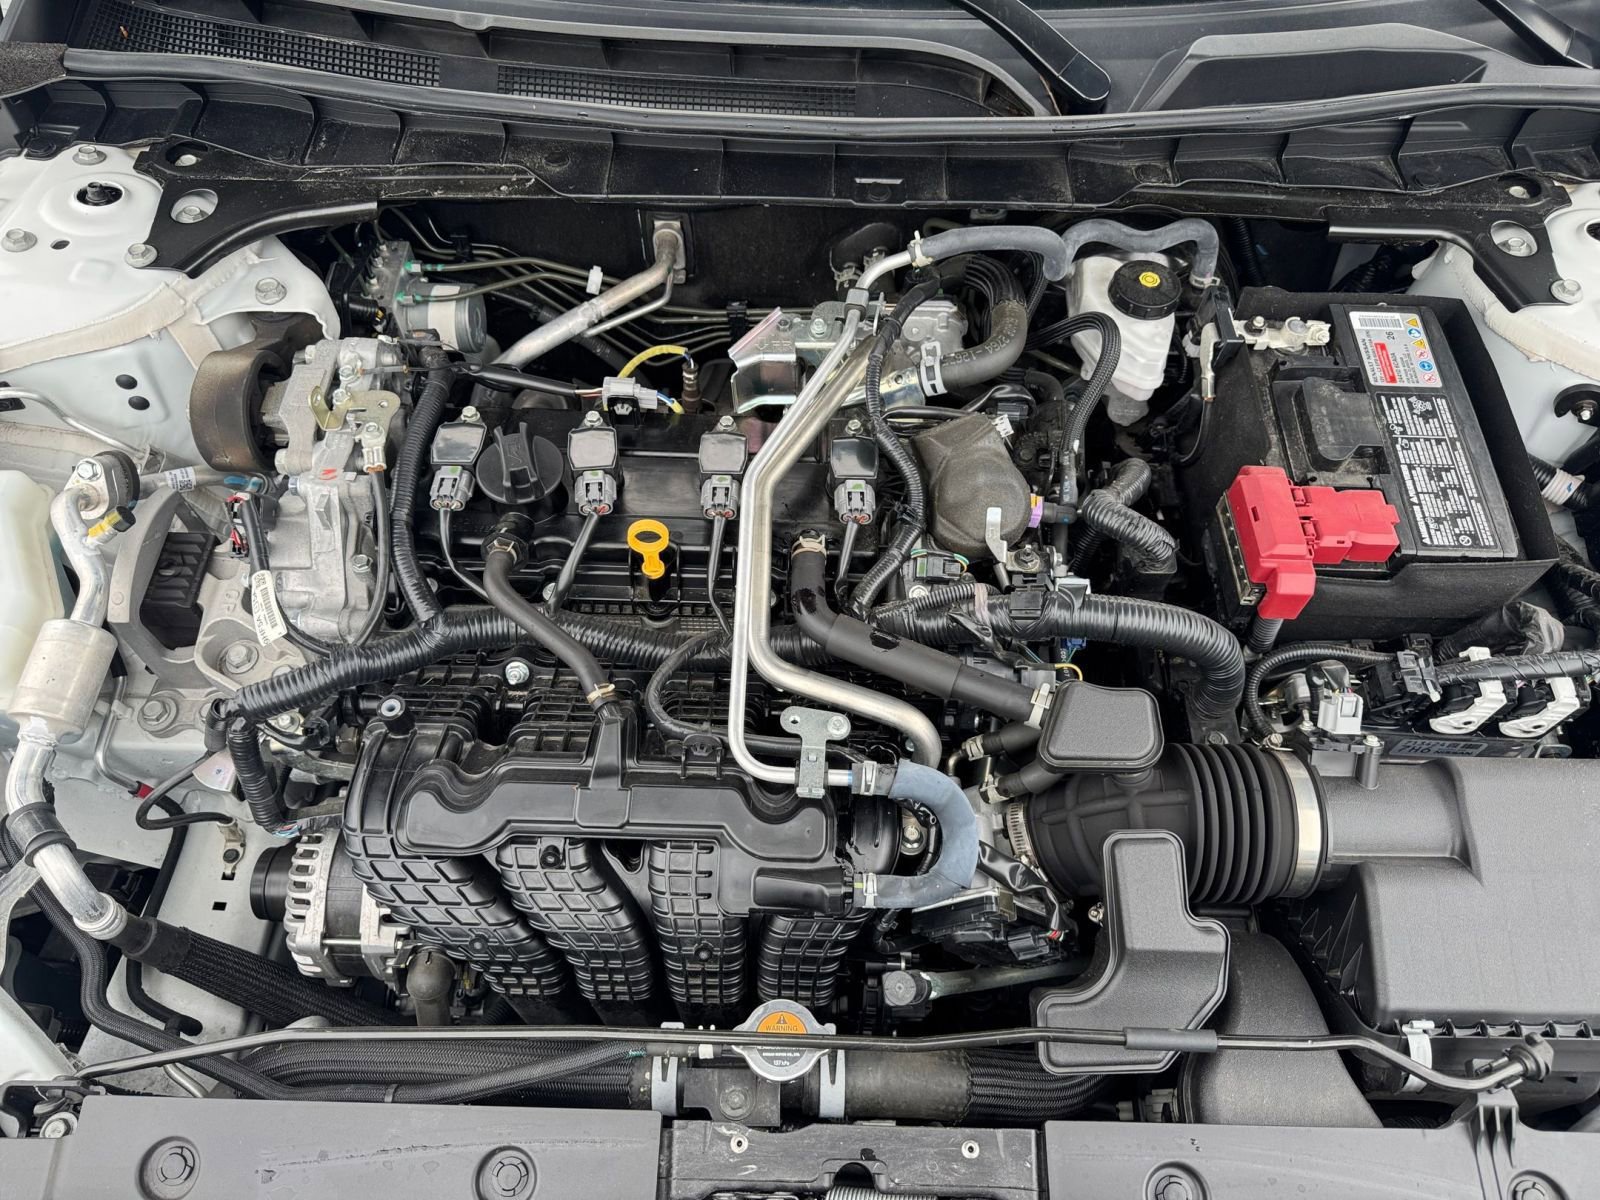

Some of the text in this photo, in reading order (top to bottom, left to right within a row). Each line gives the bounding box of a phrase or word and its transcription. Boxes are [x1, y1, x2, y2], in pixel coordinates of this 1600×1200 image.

[1385, 331, 1395, 340] 26
[1361, 339, 1371, 360] NISSAN
[1368, 361, 1378, 382] RENAULT
[765, 1024, 798, 1032] WARNING
